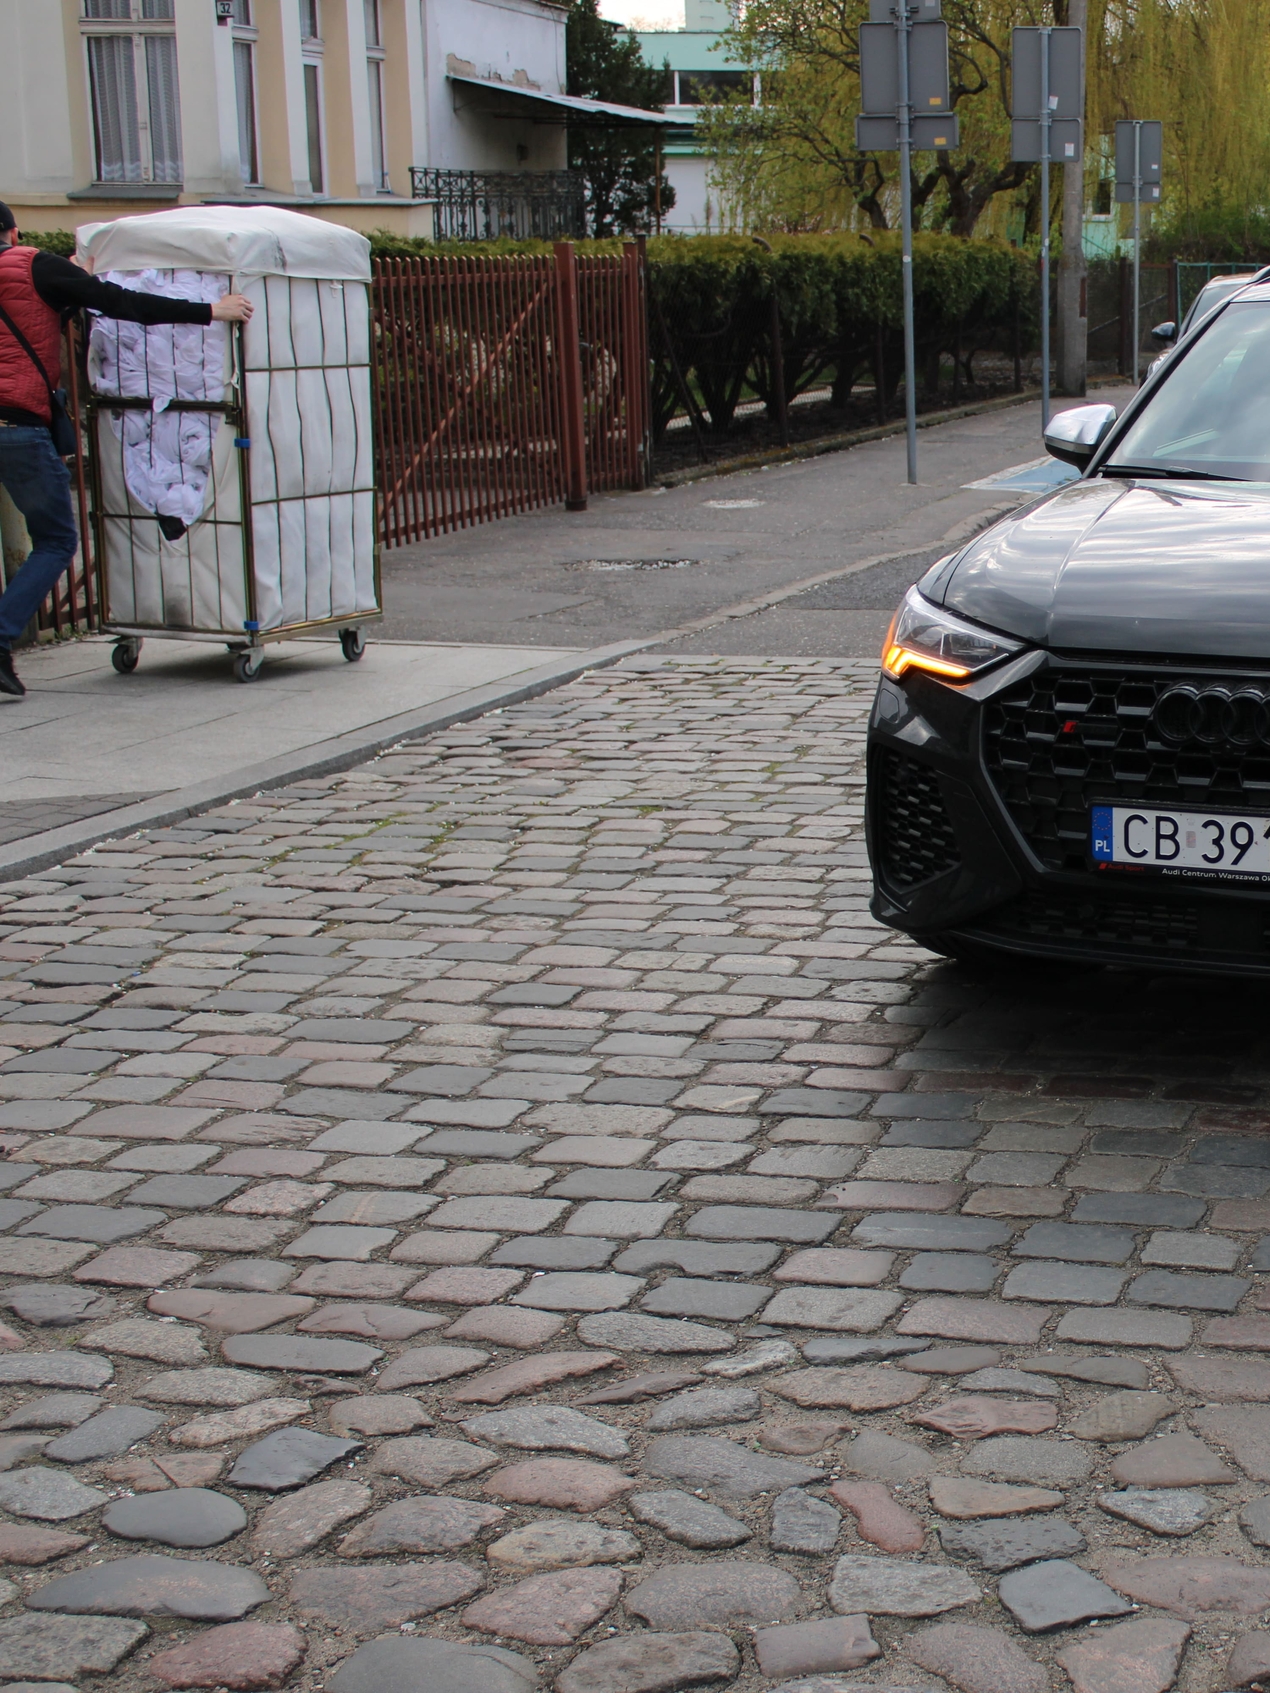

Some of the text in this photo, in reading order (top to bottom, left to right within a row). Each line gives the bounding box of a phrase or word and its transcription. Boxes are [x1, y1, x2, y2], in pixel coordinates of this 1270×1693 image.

[1124, 814, 1181, 860] CB
[1095, 840, 1110, 852] PL
[1161, 868, 1180, 876] Audi
[1182, 869, 1217, 878] Centrum
[1218, 872, 1260, 882] Warszawa
